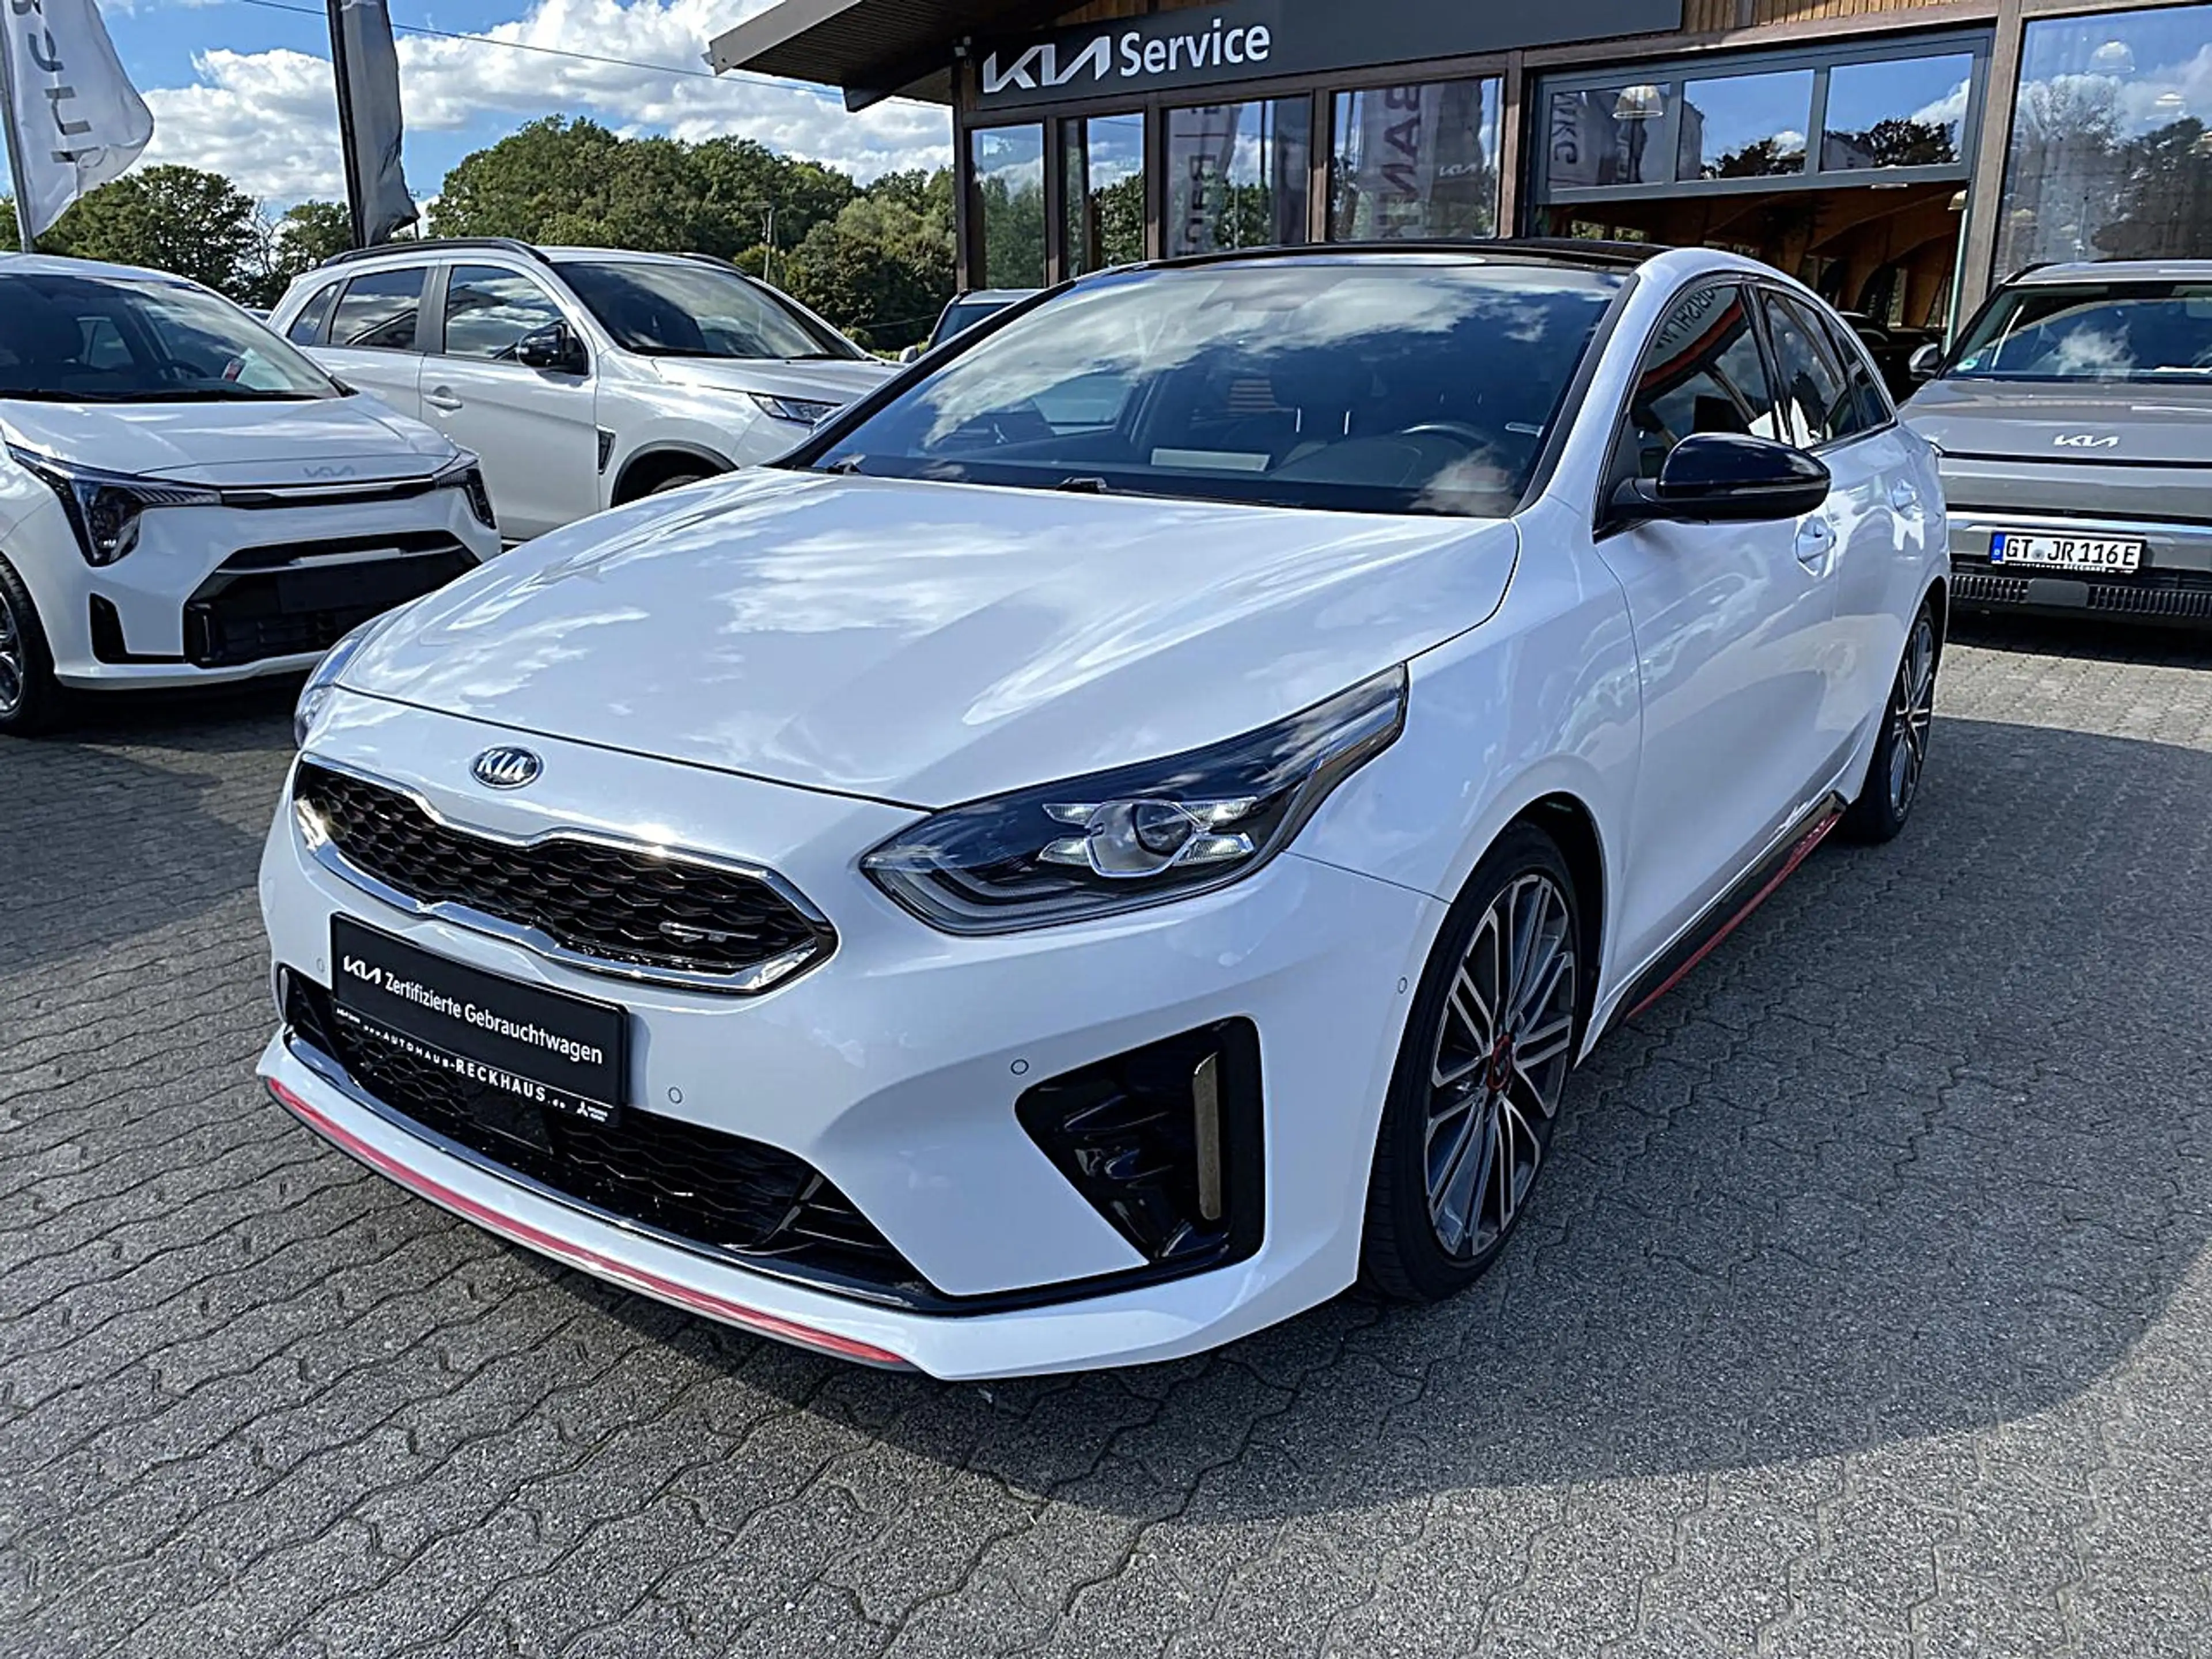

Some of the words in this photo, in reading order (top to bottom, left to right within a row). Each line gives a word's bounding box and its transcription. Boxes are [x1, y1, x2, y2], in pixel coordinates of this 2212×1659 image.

[983, 36, 1111, 93] KIA
[1120, 18, 1271, 77] Service
[2053, 434, 2119, 448] KIA
[2006, 538, 2033, 559] GT
[2048, 541, 2073, 562] JR
[475, 749, 529, 782] KIA
[343, 955, 381, 984] KIA
[385, 971, 461, 1019] Zertifizierte
[465, 1003, 603, 1065] Gebrauchtwagen
